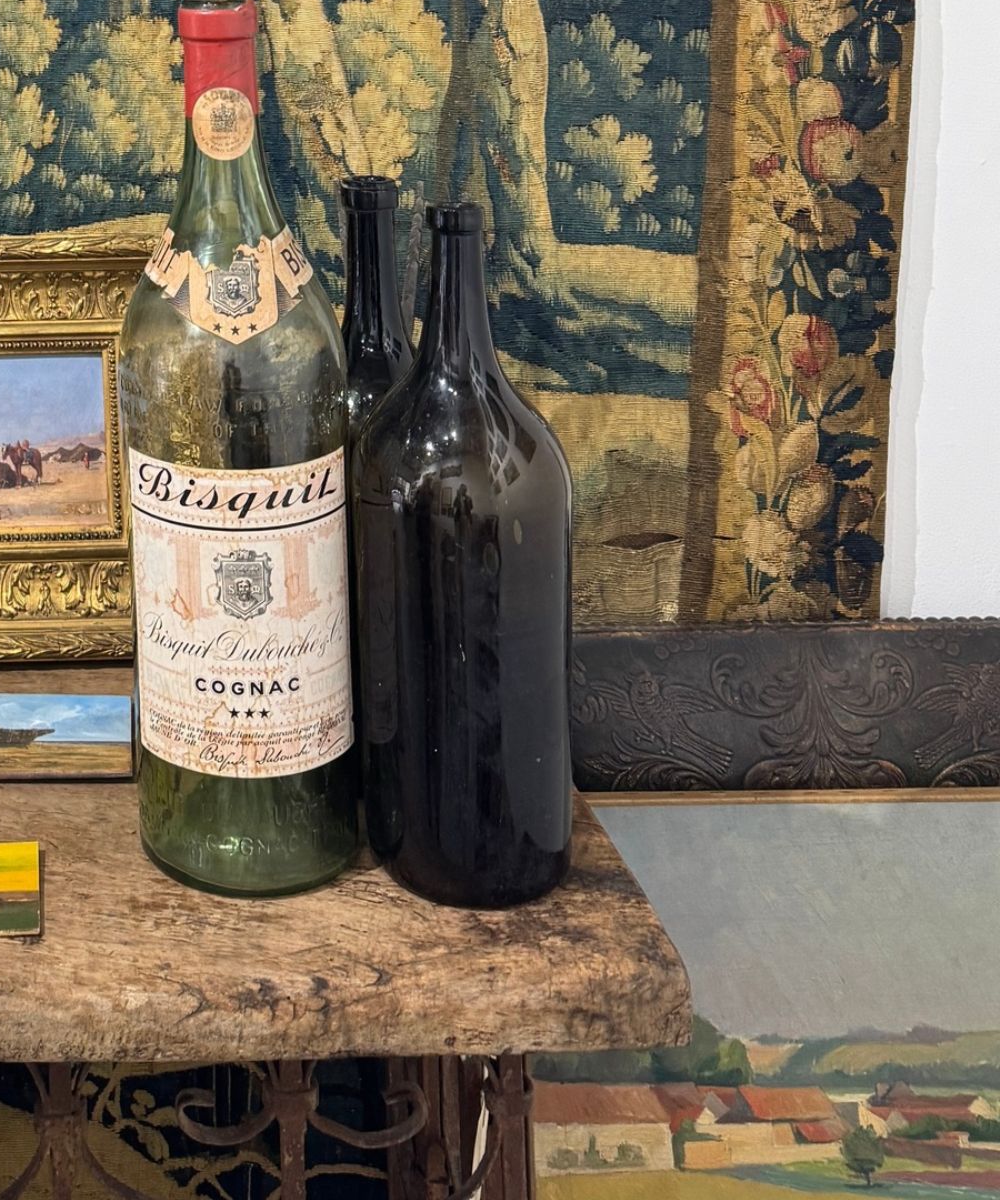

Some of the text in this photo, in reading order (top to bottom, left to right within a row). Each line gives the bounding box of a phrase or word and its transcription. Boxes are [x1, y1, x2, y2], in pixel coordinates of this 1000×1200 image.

[138, 463, 338, 519] Bisquit
[143, 611, 216, 661] Bisquit
[195, 677, 300, 696] COGNAC
